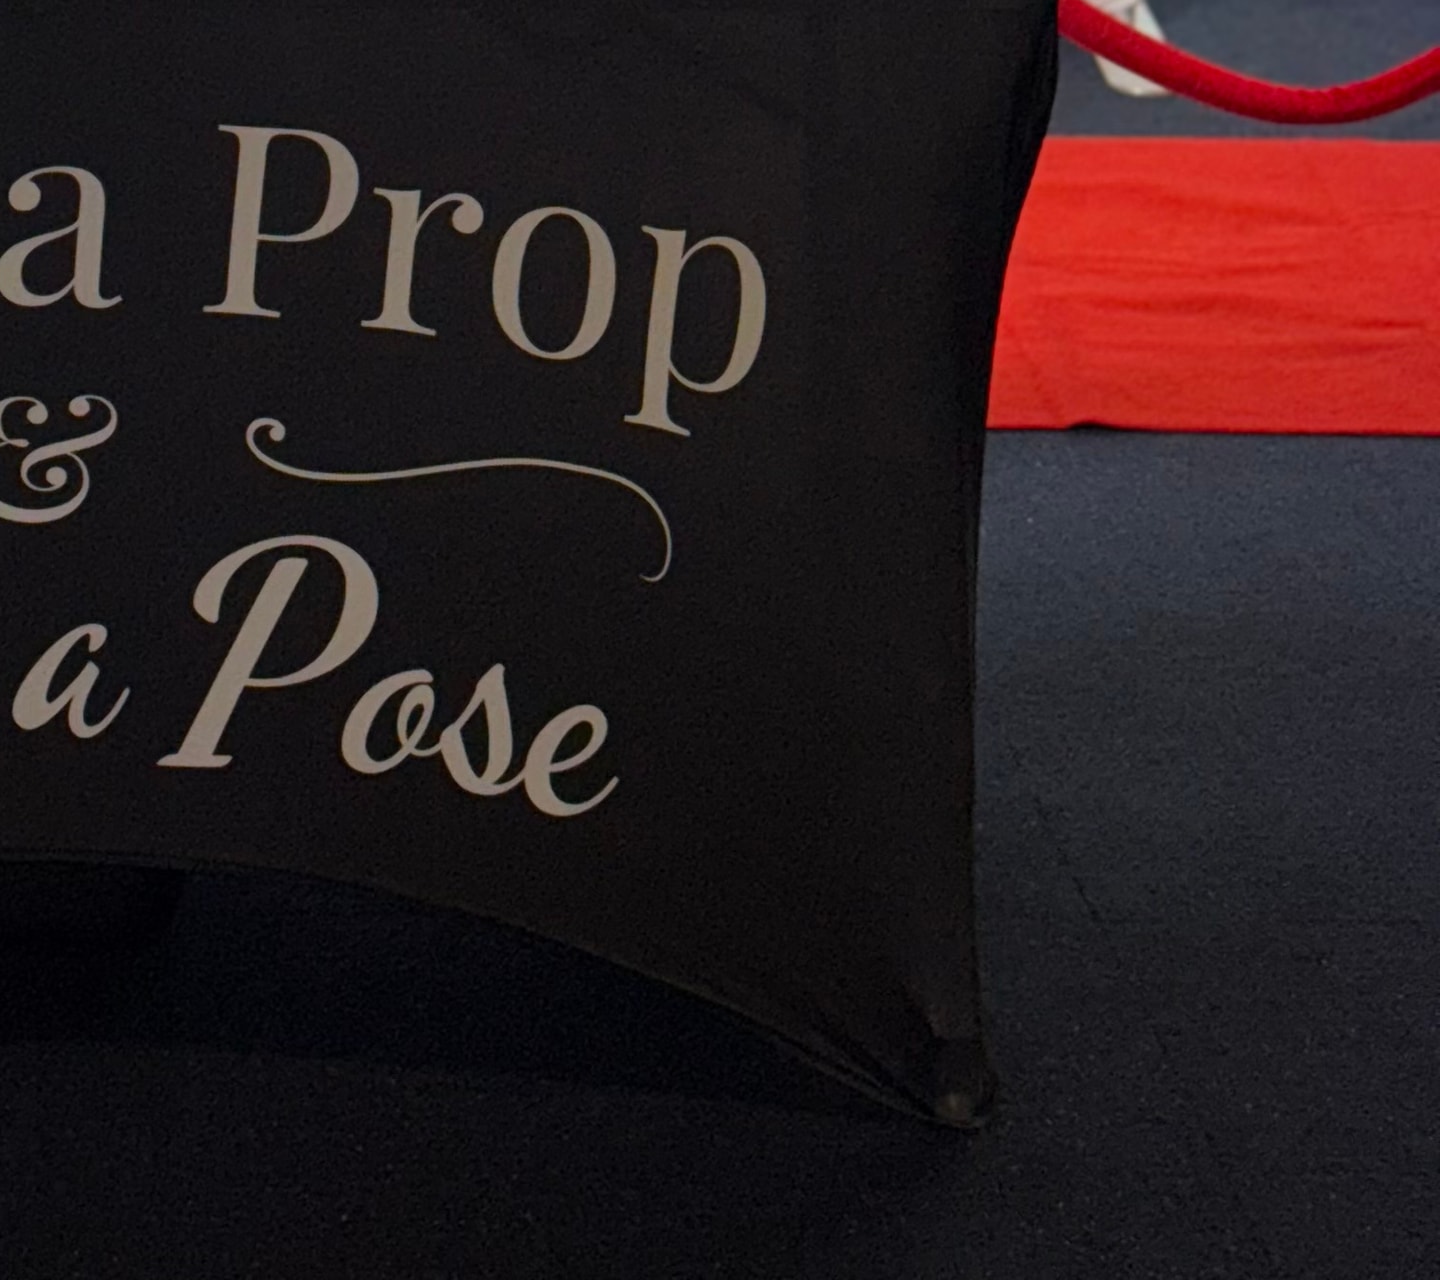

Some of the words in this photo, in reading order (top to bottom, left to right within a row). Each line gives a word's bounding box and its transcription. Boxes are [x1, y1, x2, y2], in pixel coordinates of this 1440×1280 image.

[202, 123, 767, 438] Prop
[11, 622, 131, 739] a
[156, 533, 620, 818] Pose
